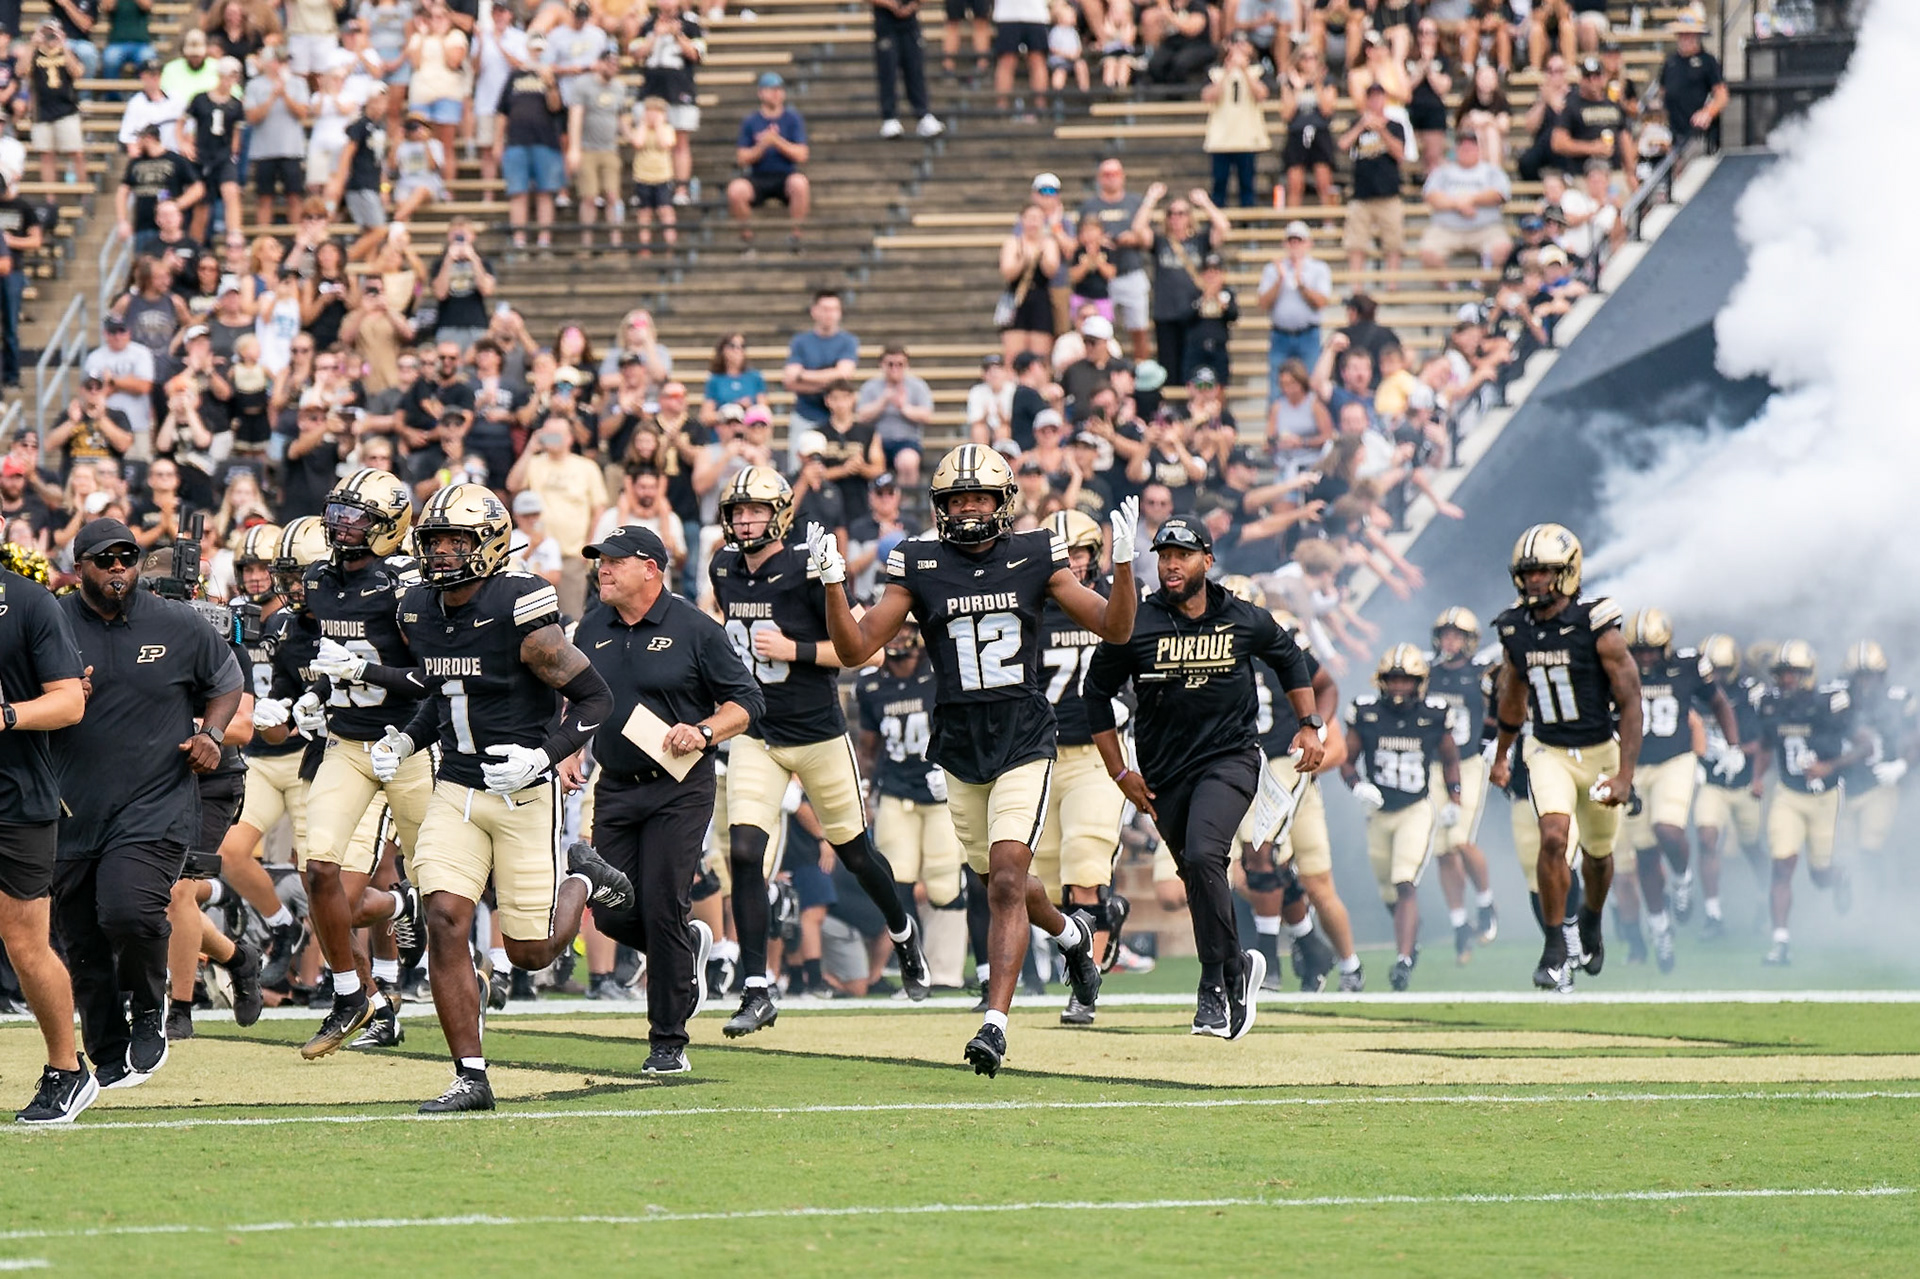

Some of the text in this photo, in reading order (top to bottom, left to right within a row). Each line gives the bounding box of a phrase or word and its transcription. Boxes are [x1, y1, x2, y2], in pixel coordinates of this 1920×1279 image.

[728, 602, 773, 618] PURDUE
[946, 591, 1019, 615] PURDUE
[320, 619, 366, 637] PURDUE
[646, 637, 674, 652] P
[1050, 630, 1104, 648] PURDU
[1156, 633, 1235, 662] PURDUE
[136, 644, 167, 664] P
[946, 611, 1025, 692] 12
[423, 656, 482, 676] PURDUE
[1184, 674, 1209, 688] P
[1526, 664, 1580, 725] 11
[441, 679, 477, 755] 1
